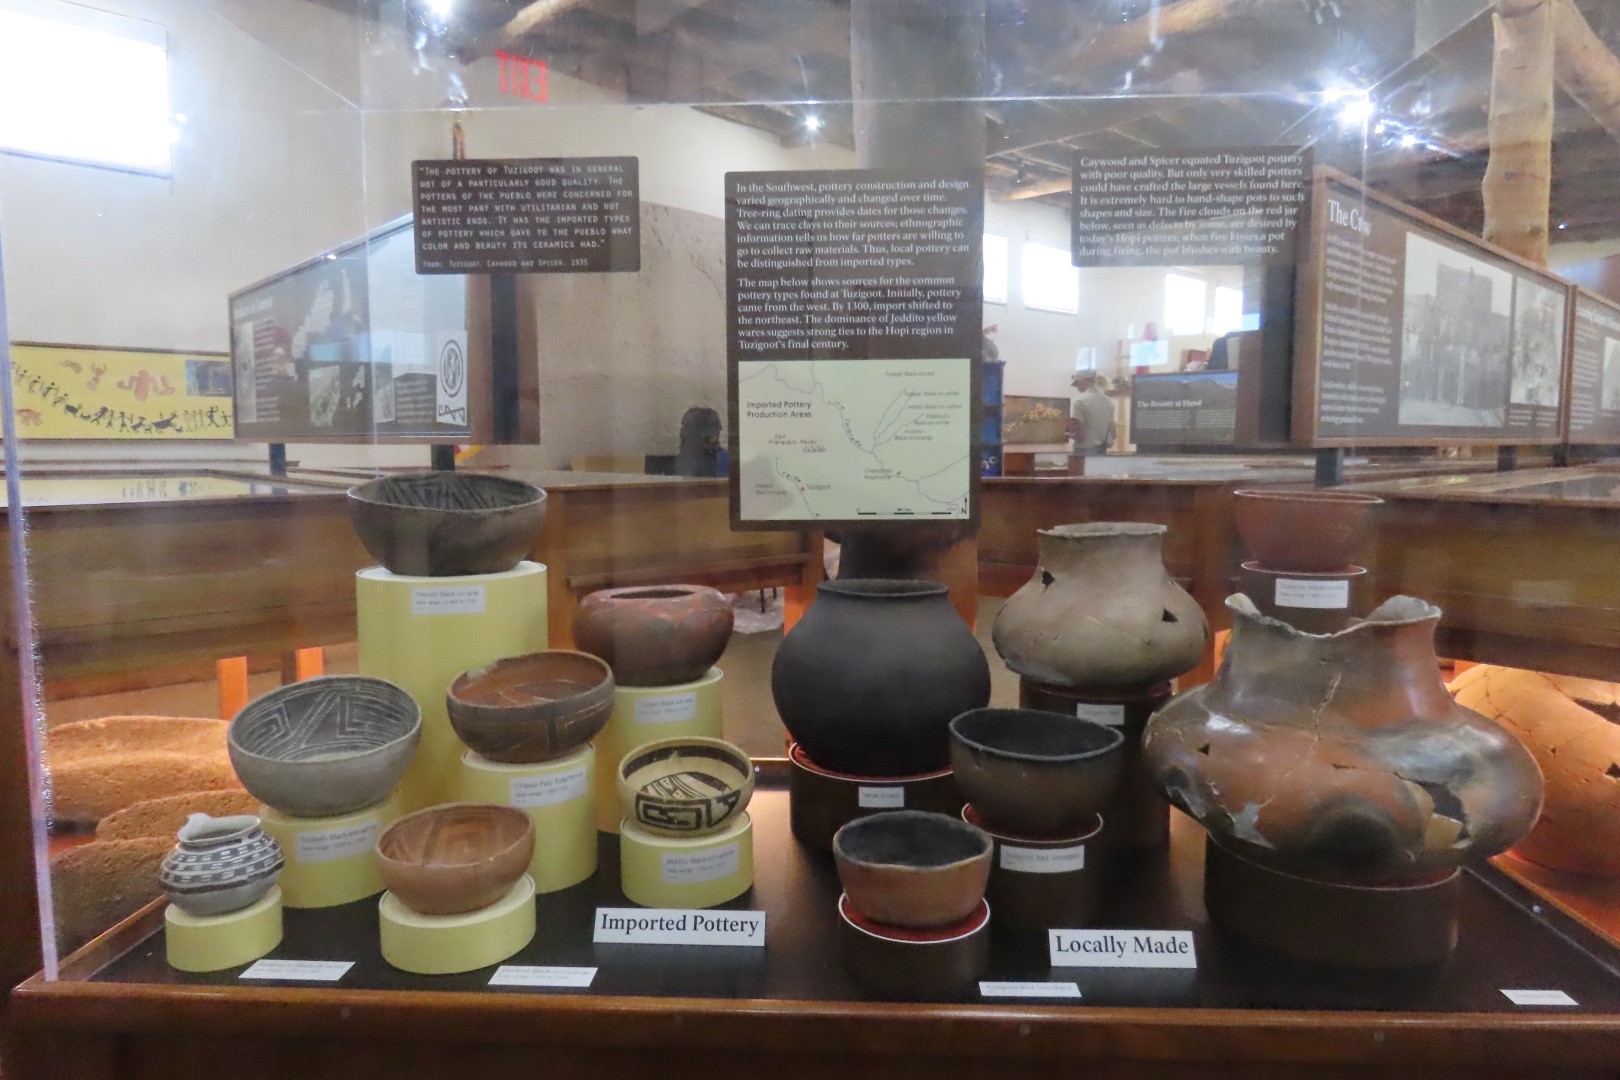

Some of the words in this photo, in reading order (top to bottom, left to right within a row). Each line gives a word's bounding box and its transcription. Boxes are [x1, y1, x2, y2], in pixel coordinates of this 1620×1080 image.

[1081, 157, 1126, 169] Caywood
[1128, 157, 1147, 166] and
[1148, 156, 1179, 168] Spicer
[1181, 155, 1221, 167] equated
[1222, 155, 1265, 166] Tuzigoot
[1266, 156, 1303, 166] pottery
[1081, 170, 1102, 179] with
[1103, 172, 1127, 181] poor
[1166, 169, 1184, 178] But
[1185, 168, 1208, 180] only
[1209, 171, 1231, 179] very
[1233, 167, 1265, 177] skilled
[1267, 168, 1302, 178] potters
[737, 183, 746, 192] In
[748, 183, 763, 192] the
[818, 183, 853, 193] pottery
[854, 181, 916, 190] construction
[917, 180, 936, 189] and
[937, 180, 968, 191] design
[1080, 183, 1107, 192] could
[1109, 182, 1131, 191] have
[1133, 182, 1168, 191] crafted
[1170, 182, 1186, 191] the
[1188, 181, 1212, 193] large
[1214, 181, 1247, 190] vessels
[1249, 180, 1278, 190] found
[736, 196, 765, 205] varied
[767, 195, 836, 207] geographically
[837, 194, 856, 203] and
[857, 194, 898, 205] changed
[737, 208, 781, 219] Tree-ring
[782, 207, 812, 219] dating
[814, 207, 855, 218] provides
[856, 206, 881, 215] dates
[883, 206, 898, 215] for
[899, 206, 925, 215] those
[1328, 199, 1348, 226] The
[738, 259, 748, 268] be
[750, 258, 813, 270] distinguished
[814, 258, 838, 267] from
[840, 257, 884, 269] imported
[738, 278, 756, 287] The
[757, 281, 778, 289] map
[780, 277, 809, 286] below
[810, 277, 840, 286] shows
[878, 276, 893, 285] for
[895, 276, 910, 285] the
[738, 292, 771, 301] pottery
[773, 291, 798, 301] types
[800, 290, 828, 299] found
[926, 289, 962, 299] pottery
[763, 302, 787, 312] from
[788, 302, 804, 311] the
[832, 302, 845, 313] By
[873, 301, 906, 312] import
[907, 301, 940, 310] shifted
[738, 315, 753, 324] the
[803, 315, 822, 324] The
[824, 314, 876, 323] dominance
[878, 314, 888, 323] of
[889, 313, 924, 325] Jeddito
[926, 313, 957, 324] yellow
[739, 340, 786, 351] Tuzigoot's
[787, 340, 809, 349] final
[784, 401, 812, 410] Pottery
[601, 914, 687, 934] Imported
[692, 915, 759, 937] Pottery
[1055, 935, 1127, 958] Locally
[1133, 936, 1188, 954] Made
